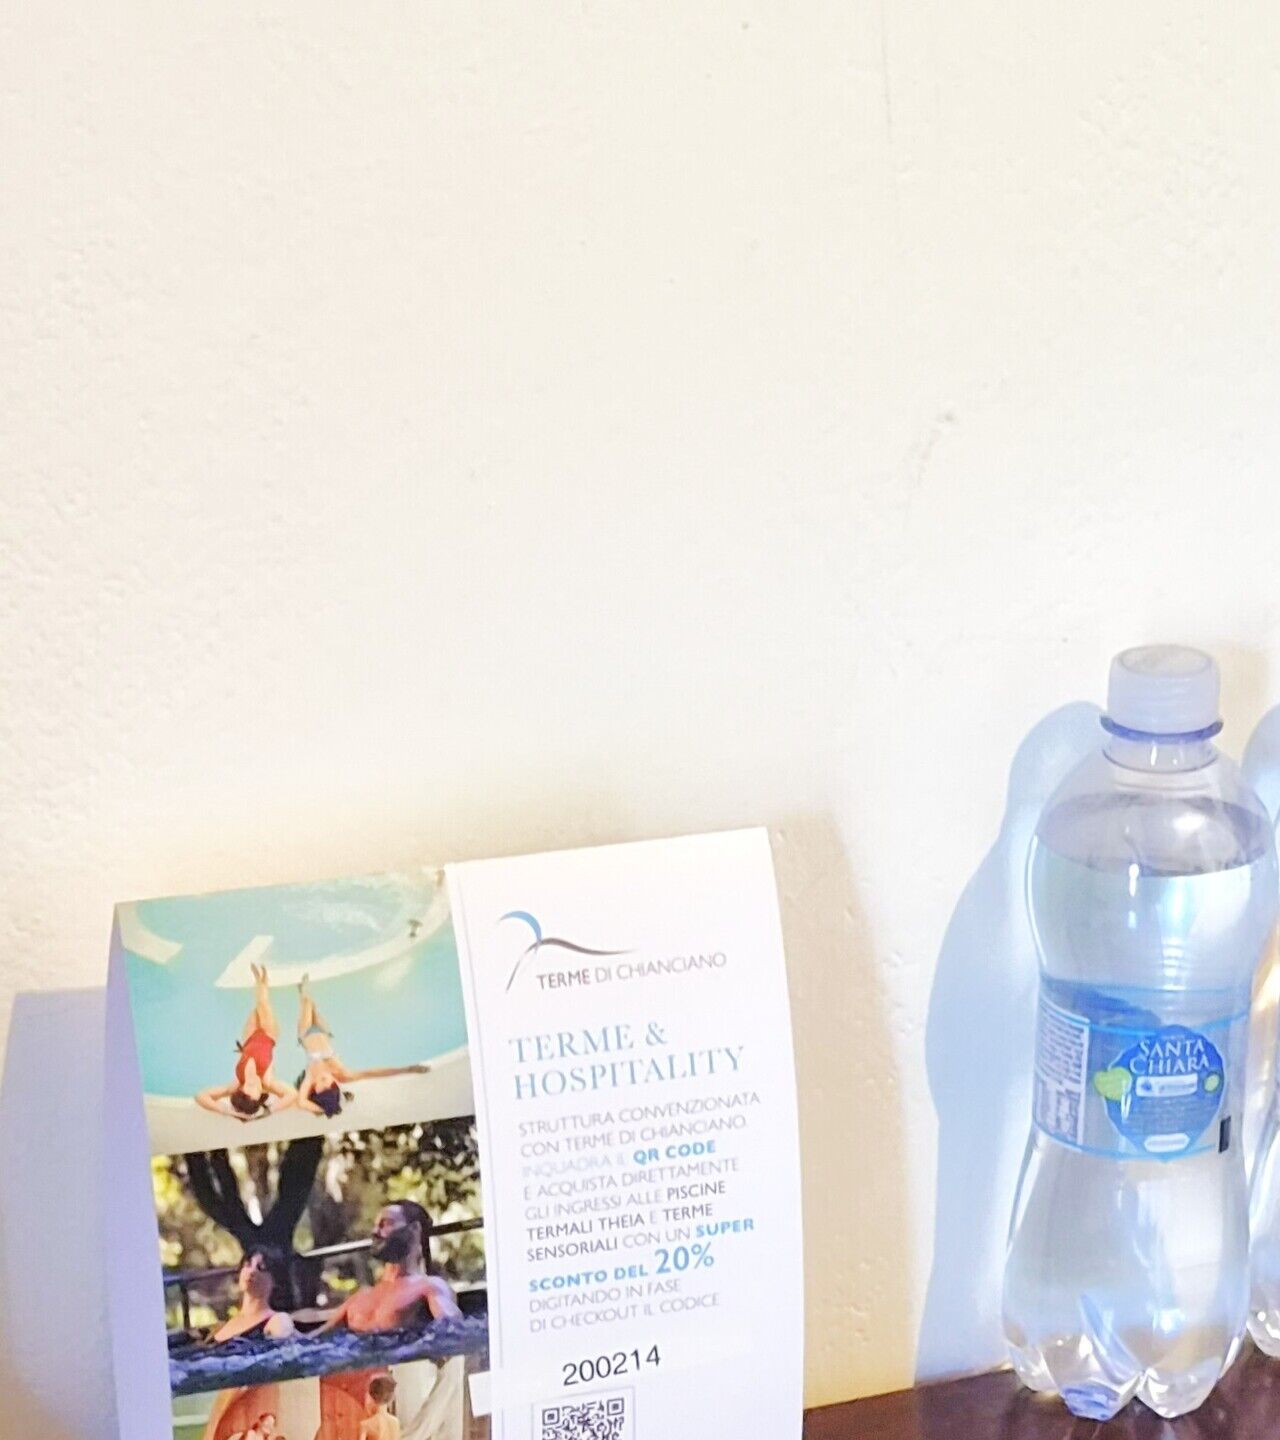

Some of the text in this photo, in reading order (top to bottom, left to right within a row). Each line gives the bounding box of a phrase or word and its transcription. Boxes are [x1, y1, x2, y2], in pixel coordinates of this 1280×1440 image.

[536, 952, 727, 990] TERME DI CHIANCIANO
[508, 1022, 667, 1063] TERME &
[1140, 1038, 1206, 1059] SANTA
[514, 1045, 744, 1100] HOSPITALITY
[1129, 1054, 1210, 1075] CHIARA
[518, 1091, 761, 1138] STRUTTURA CONVENZIONATA
[520, 1114, 747, 1158] CON TERME DI CHIANCIANO
[632, 1147, 661, 1167] QR
[664, 1139, 716, 1160] CODE
[523, 1157, 737, 1201] E ACQUISTA DIRETTAMENTE
[524, 1180, 726, 1221] GLI INGRESSI ALLE PISCINE
[526, 1219, 593, 1242] TERMALI
[597, 1212, 646, 1232] THEIA
[662, 1202, 713, 1222] TERME
[527, 1218, 755, 1262] SENSORIALI CON UN SUPER
[529, 1241, 715, 1292] SCONTO DEL 20%
[528, 1278, 680, 1314] DIGITANDO IN FASE
[529, 1292, 719, 1333] DI CHECKOUT IL CODICE
[562, 1344, 662, 1386] 200214
